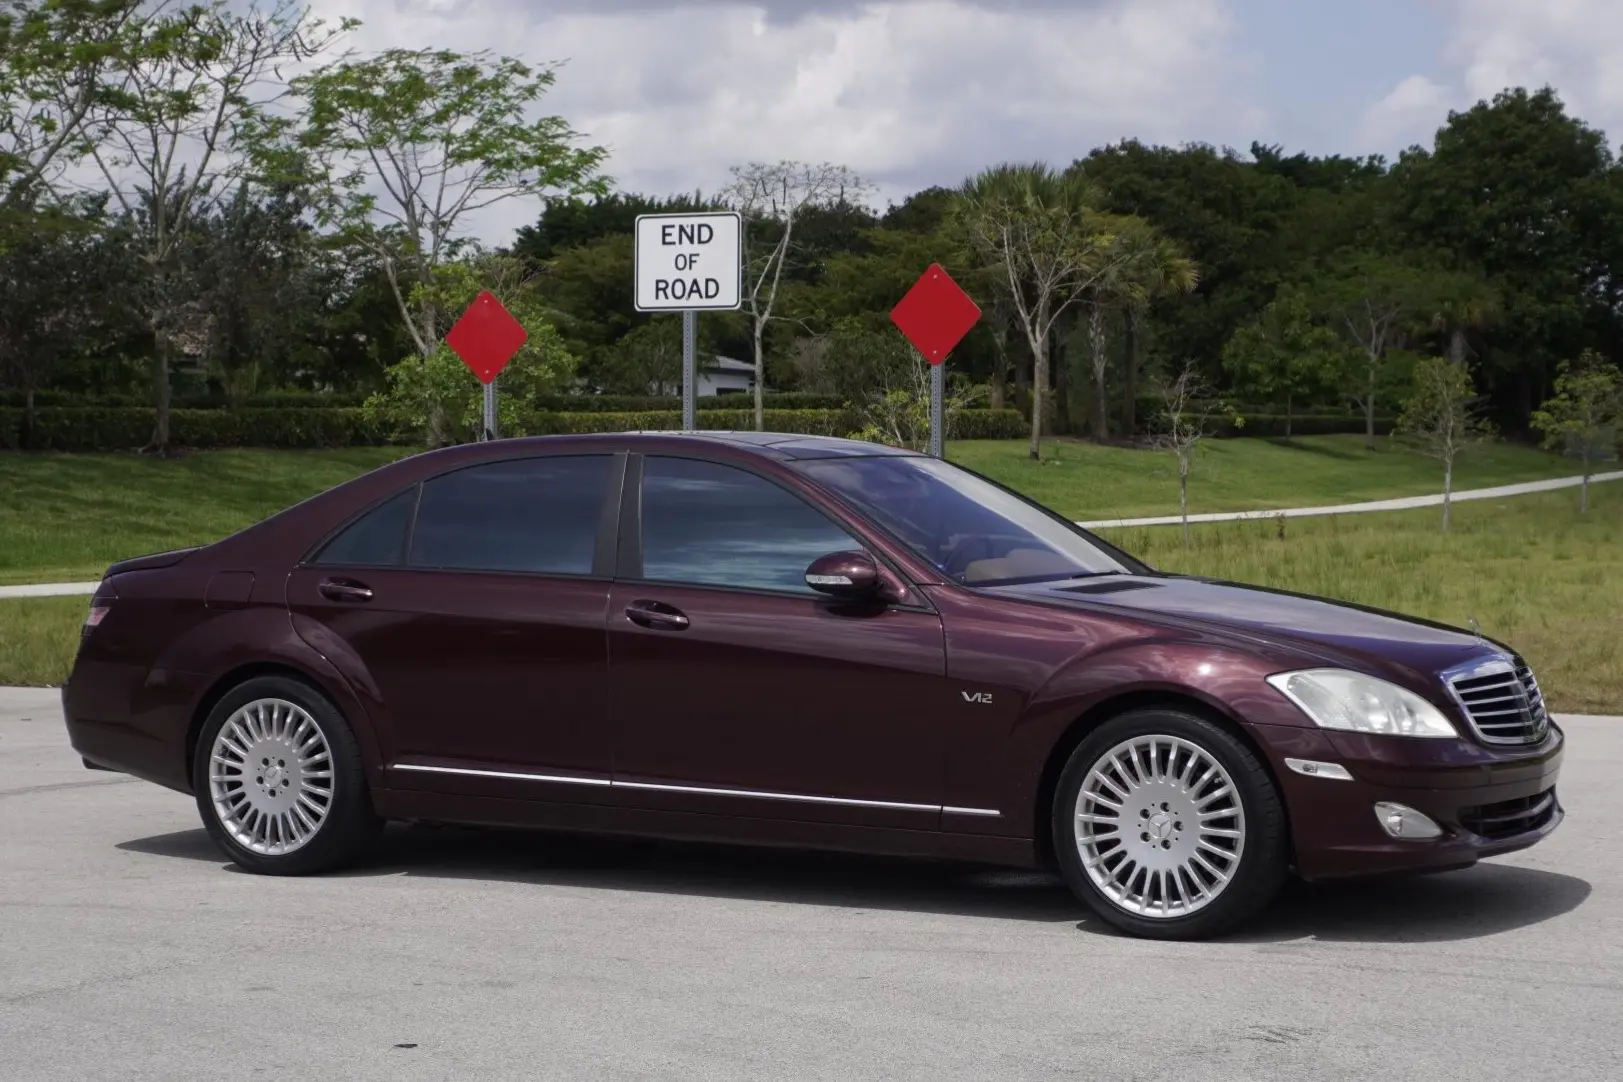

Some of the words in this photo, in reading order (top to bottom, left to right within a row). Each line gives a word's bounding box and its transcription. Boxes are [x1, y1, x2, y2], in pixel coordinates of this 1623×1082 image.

[661, 223, 713, 246] END
[674, 253, 700, 271] OF
[655, 278, 720, 300] ROAD
[961, 691, 993, 704] V12
